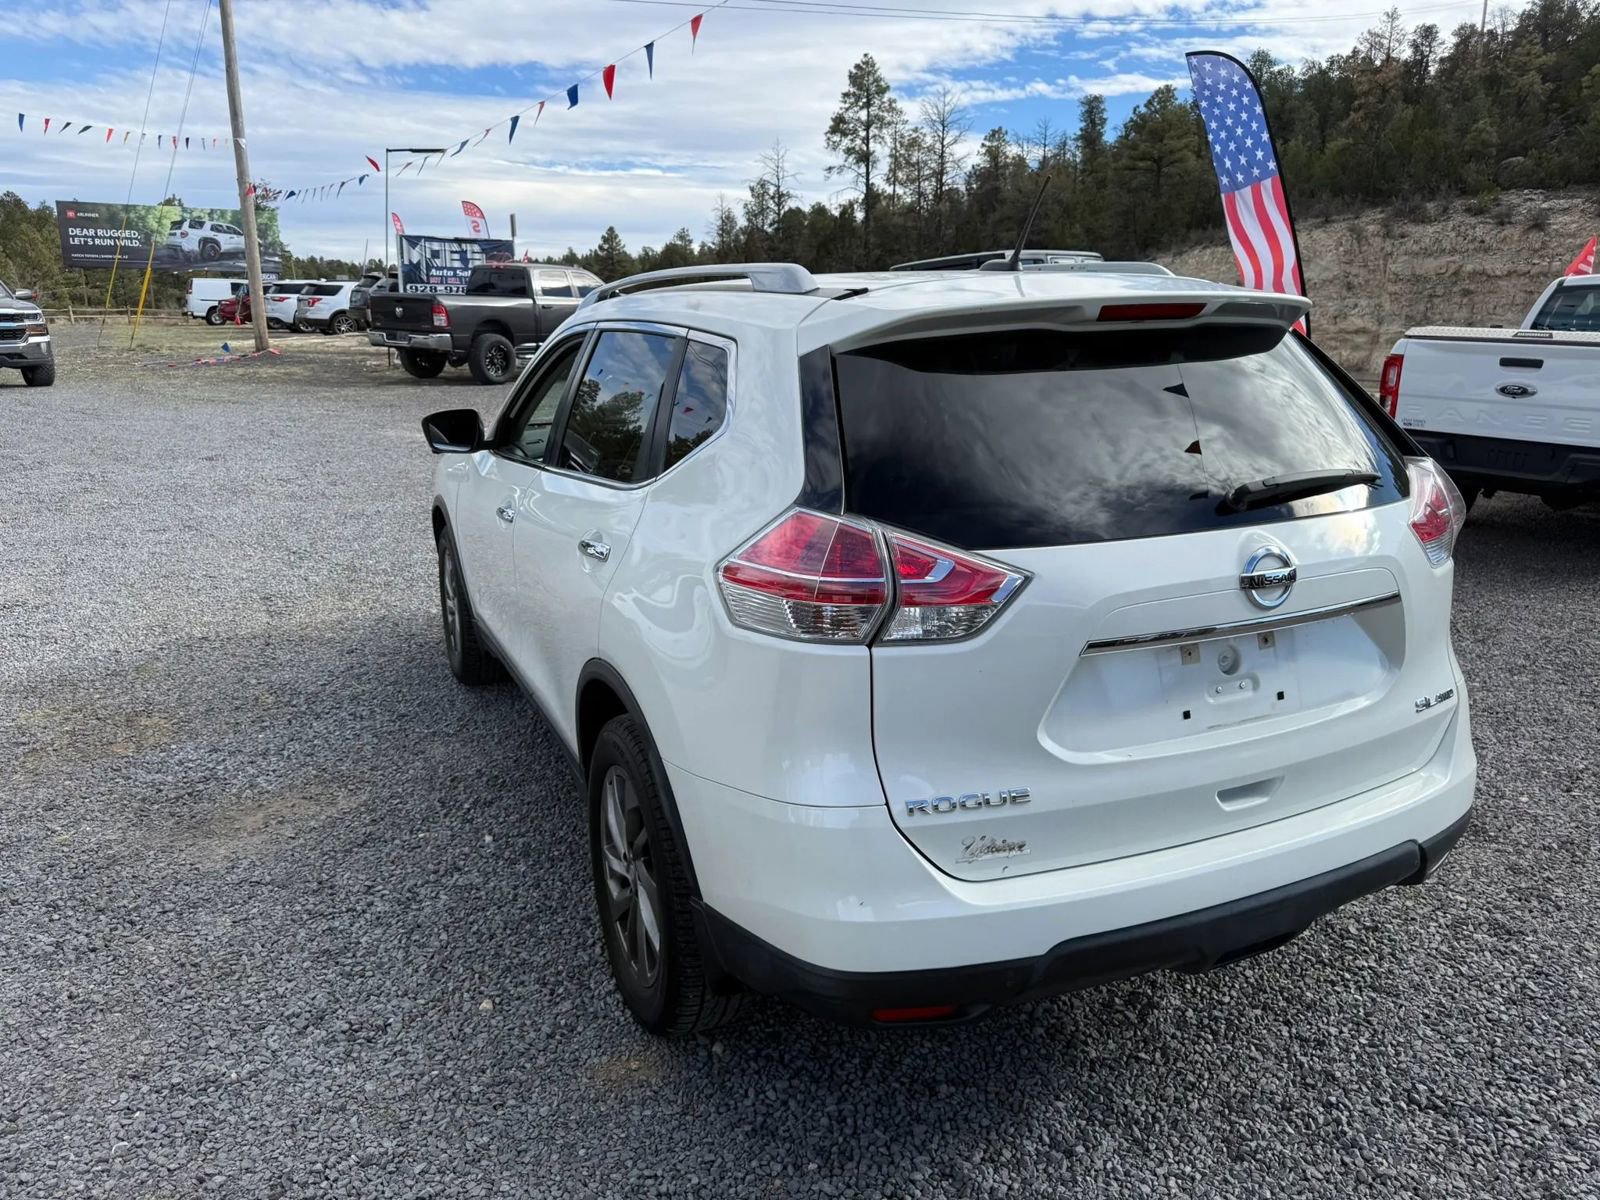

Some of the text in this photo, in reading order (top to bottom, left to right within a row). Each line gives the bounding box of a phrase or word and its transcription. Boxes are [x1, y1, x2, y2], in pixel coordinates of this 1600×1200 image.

[68, 228, 140, 239] DEAR RUGGED,
[115, 238, 142, 247] WILD.
[430, 269, 453, 277] Auto
[1250, 570, 1296, 588] NISSAN
[905, 787, 1032, 817] ROGUE
